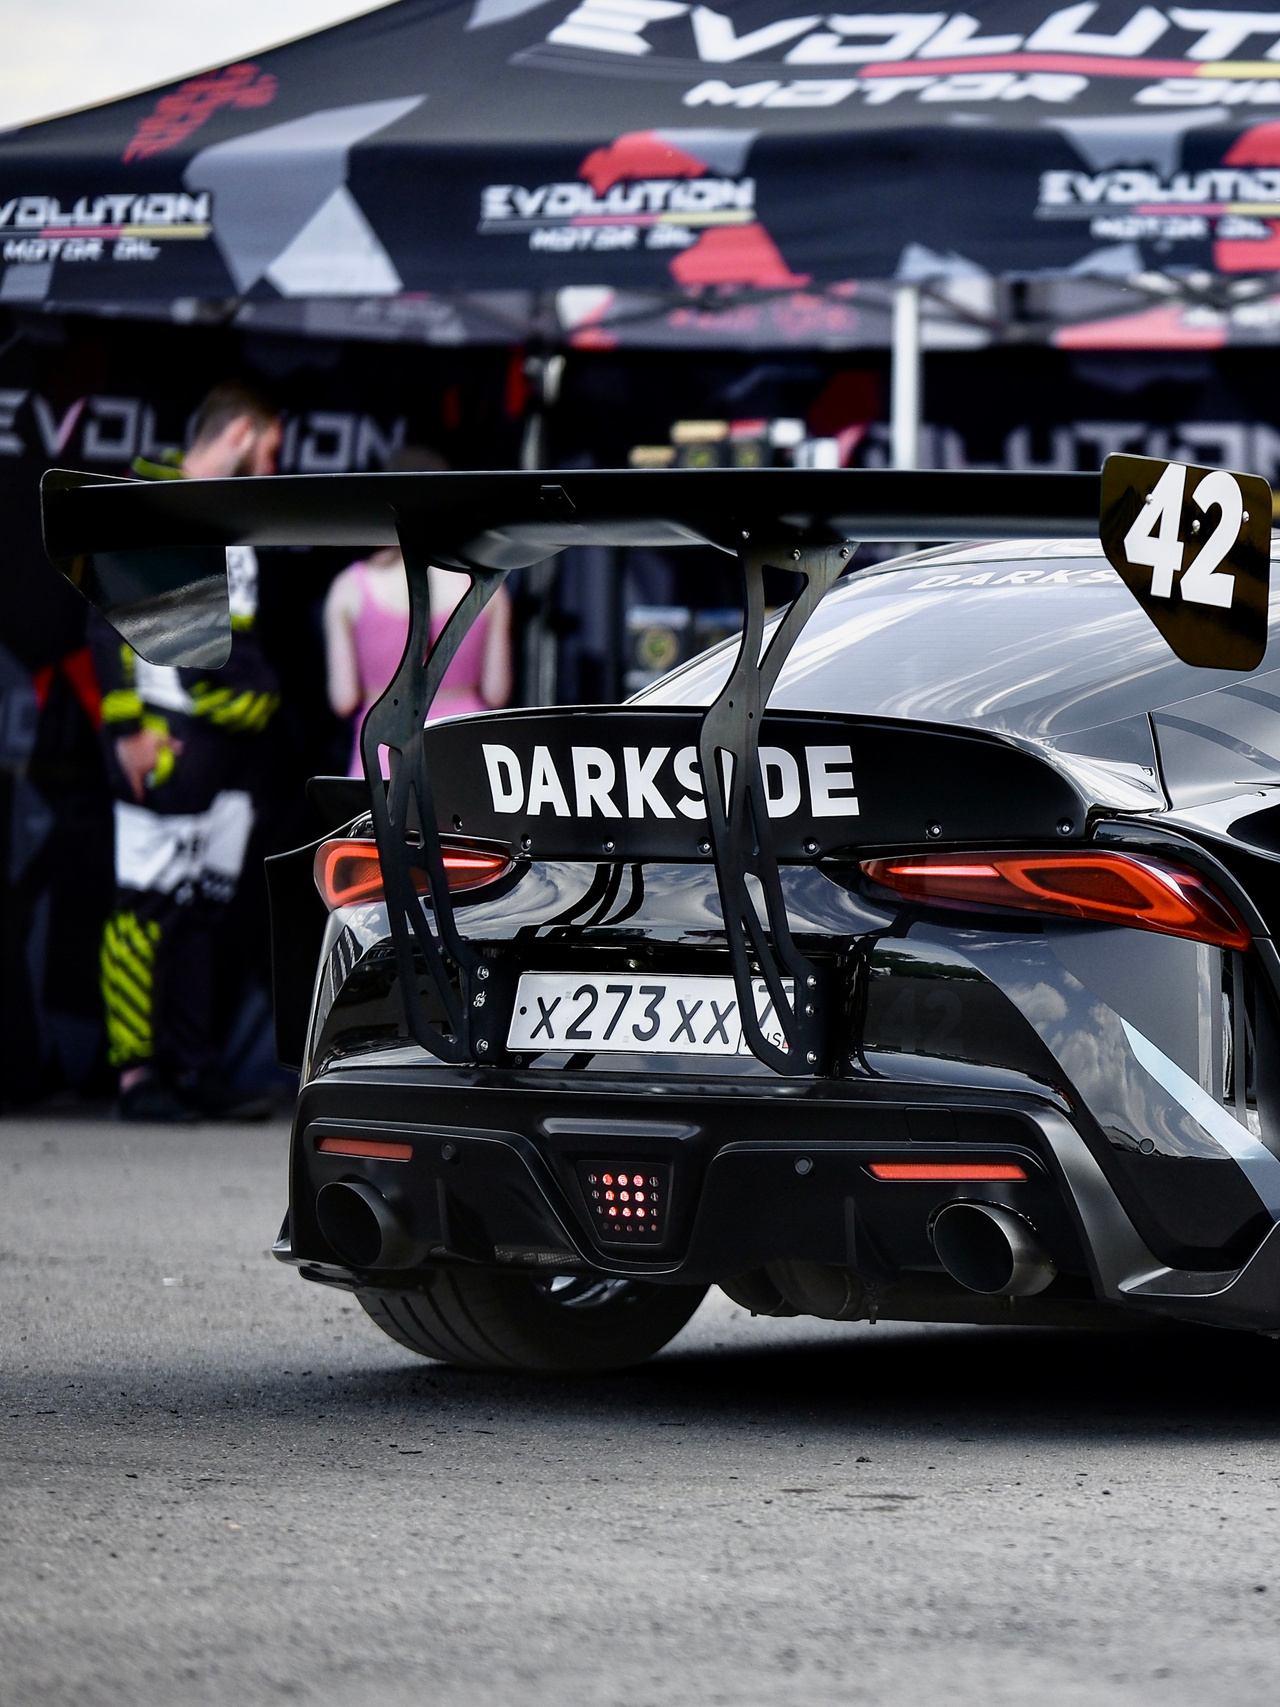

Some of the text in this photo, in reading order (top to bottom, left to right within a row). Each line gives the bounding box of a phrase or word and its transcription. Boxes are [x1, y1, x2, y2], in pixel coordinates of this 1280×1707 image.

[682, 70, 1090, 108] MOTOR
[480, 177, 757, 217] EVOLUTION
[3, 237, 161, 263] MOTOR OIL
[528, 225, 639, 252] MOTOR
[1123, 463, 1244, 609] 42
[907, 568, 1126, 591] DARKS
